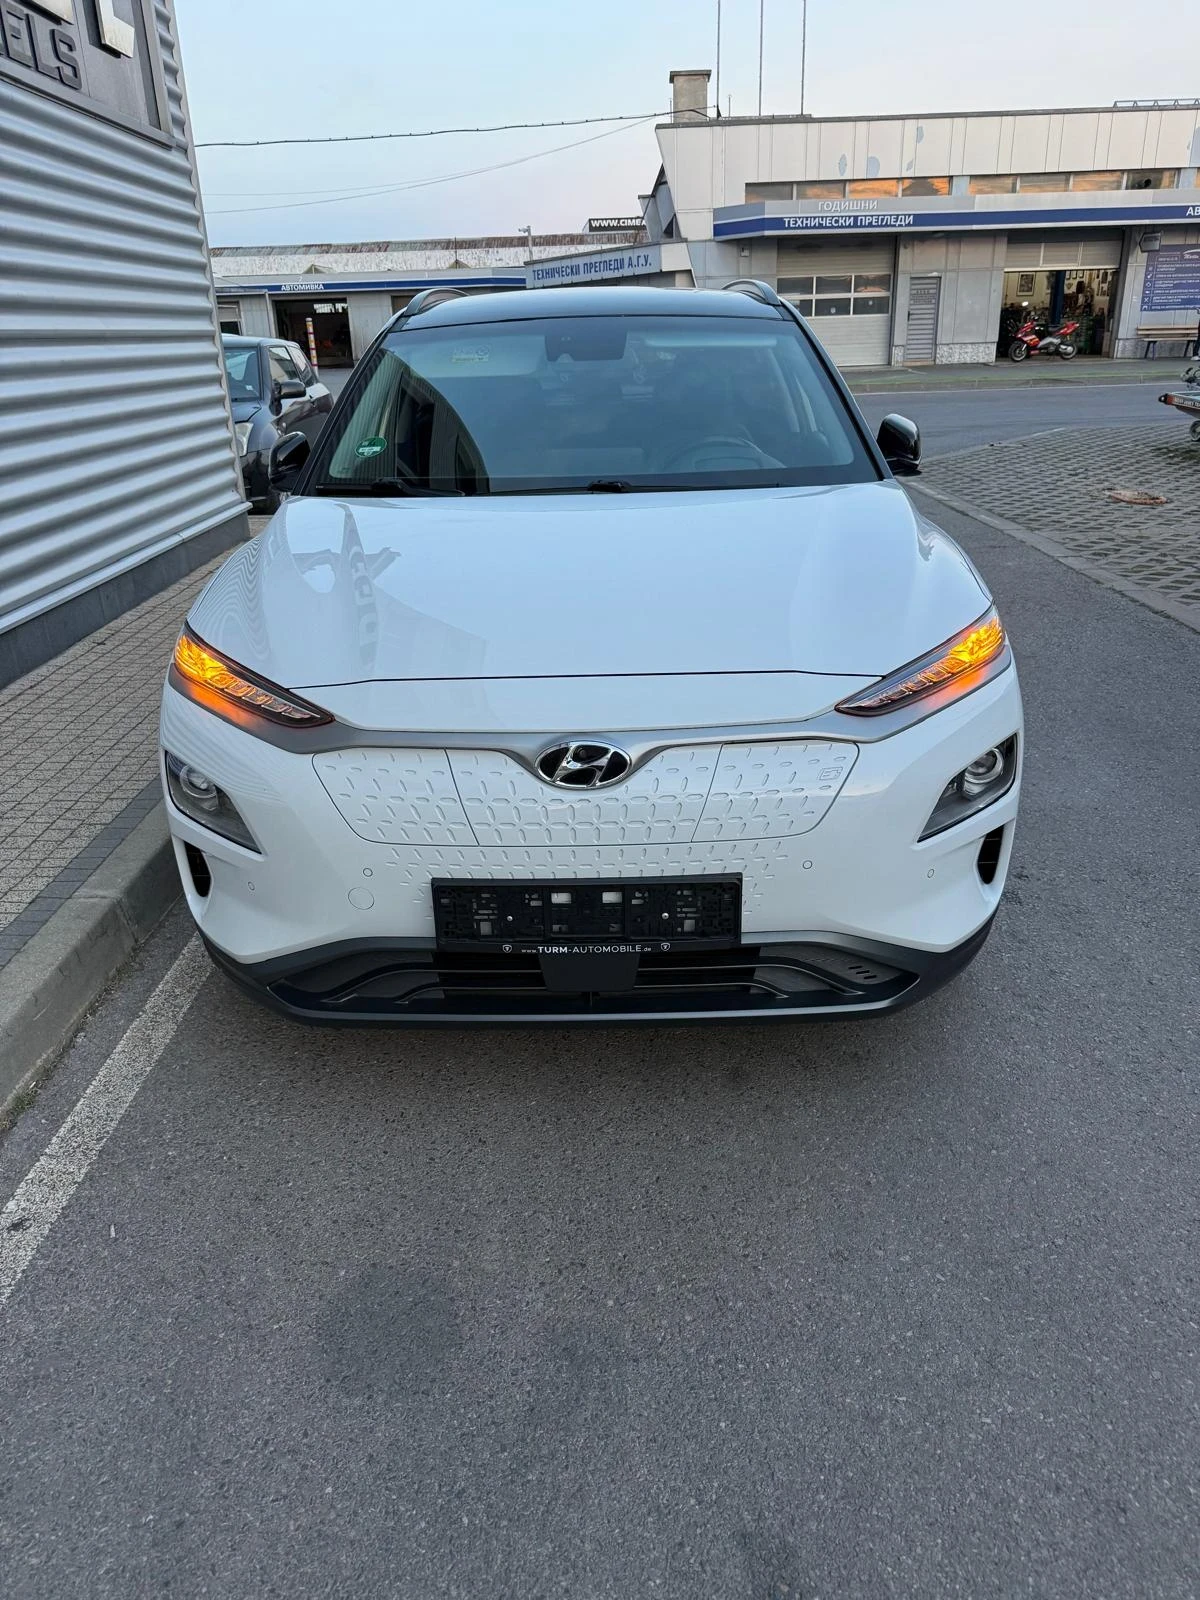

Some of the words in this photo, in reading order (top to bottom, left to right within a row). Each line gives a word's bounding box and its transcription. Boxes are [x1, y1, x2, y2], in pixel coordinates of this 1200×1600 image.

[818, 199, 879, 212] ГОДИШНИ
[783, 215, 855, 228] ТЕХНИЧЕСКИ
[857, 214, 914, 227] ПРЕГЛЕДИ
[532, 263, 581, 281] ТЕХНИЧЕСКИ
[583, 257, 625, 275] ПРЕГЛЕДИ
[627, 254, 652, 269] А.Г.У.
[281, 283, 325, 291] АВТОМИВКА
